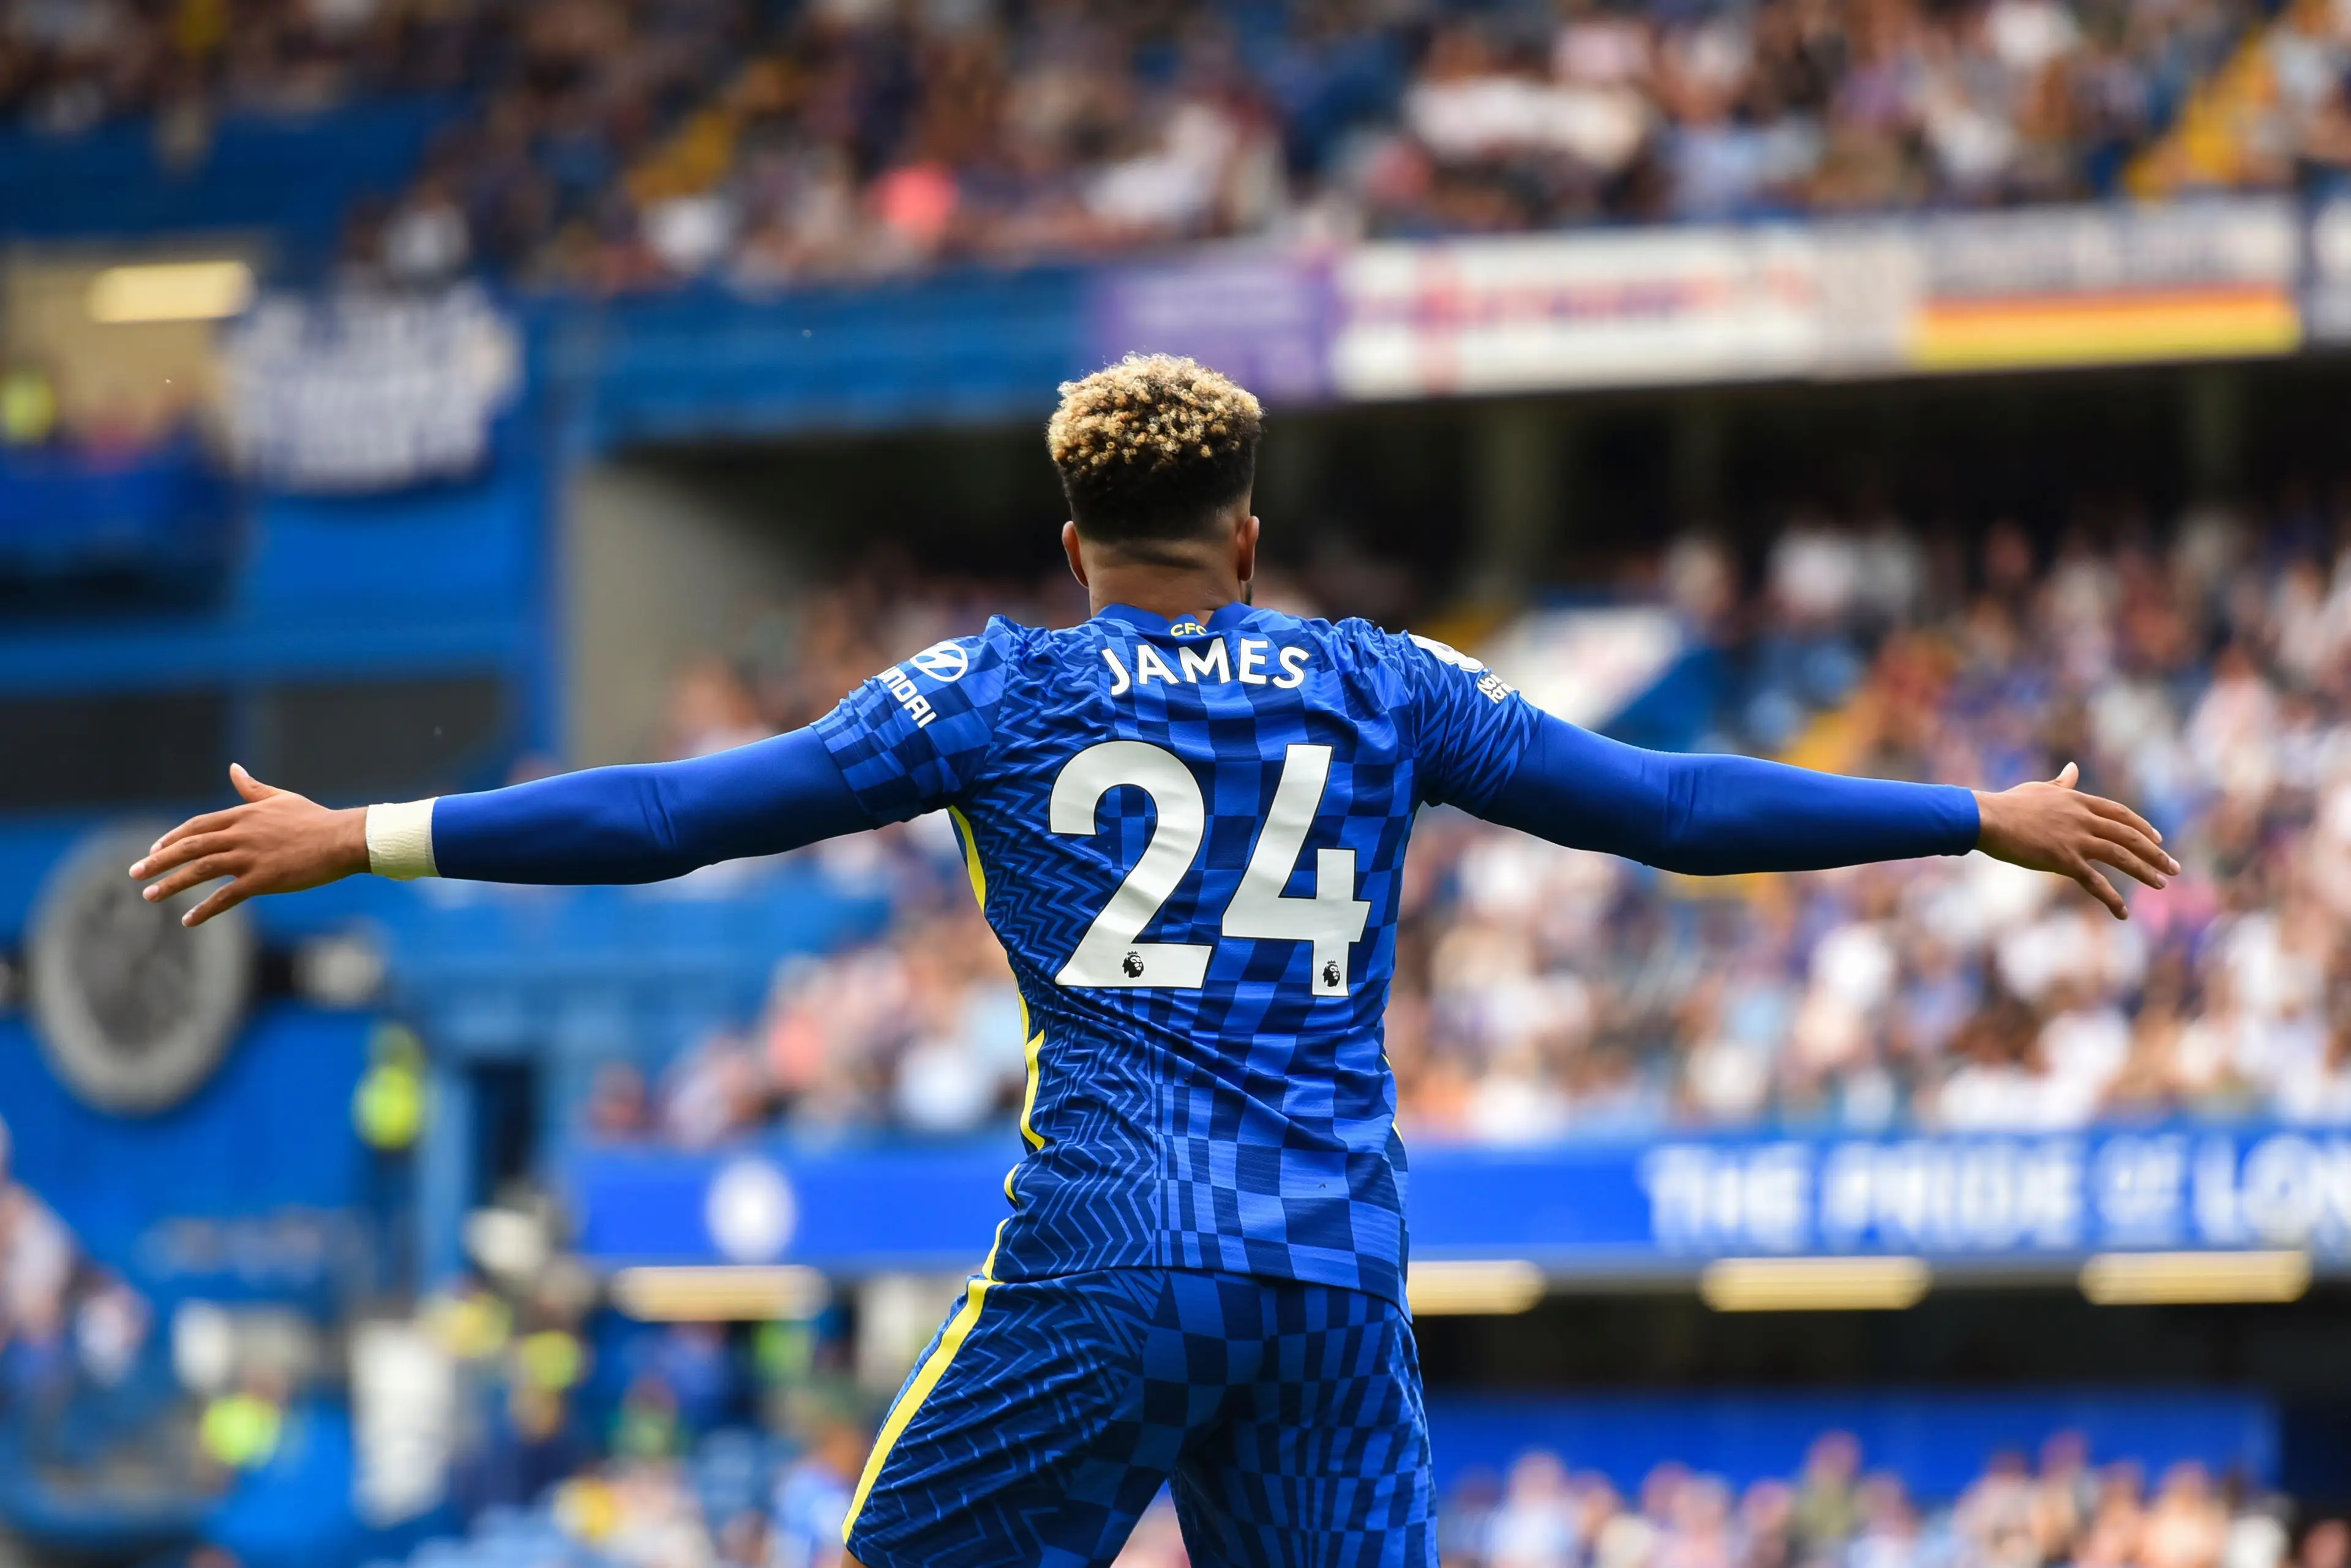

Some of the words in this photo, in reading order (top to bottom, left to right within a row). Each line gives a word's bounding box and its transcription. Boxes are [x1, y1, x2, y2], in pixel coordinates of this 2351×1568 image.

[1101, 637, 1311, 696] JAMES
[1049, 740, 1372, 997] 24
[1644, 1140, 1809, 1250] THE
[1821, 1138, 2082, 1247] PRIDE
